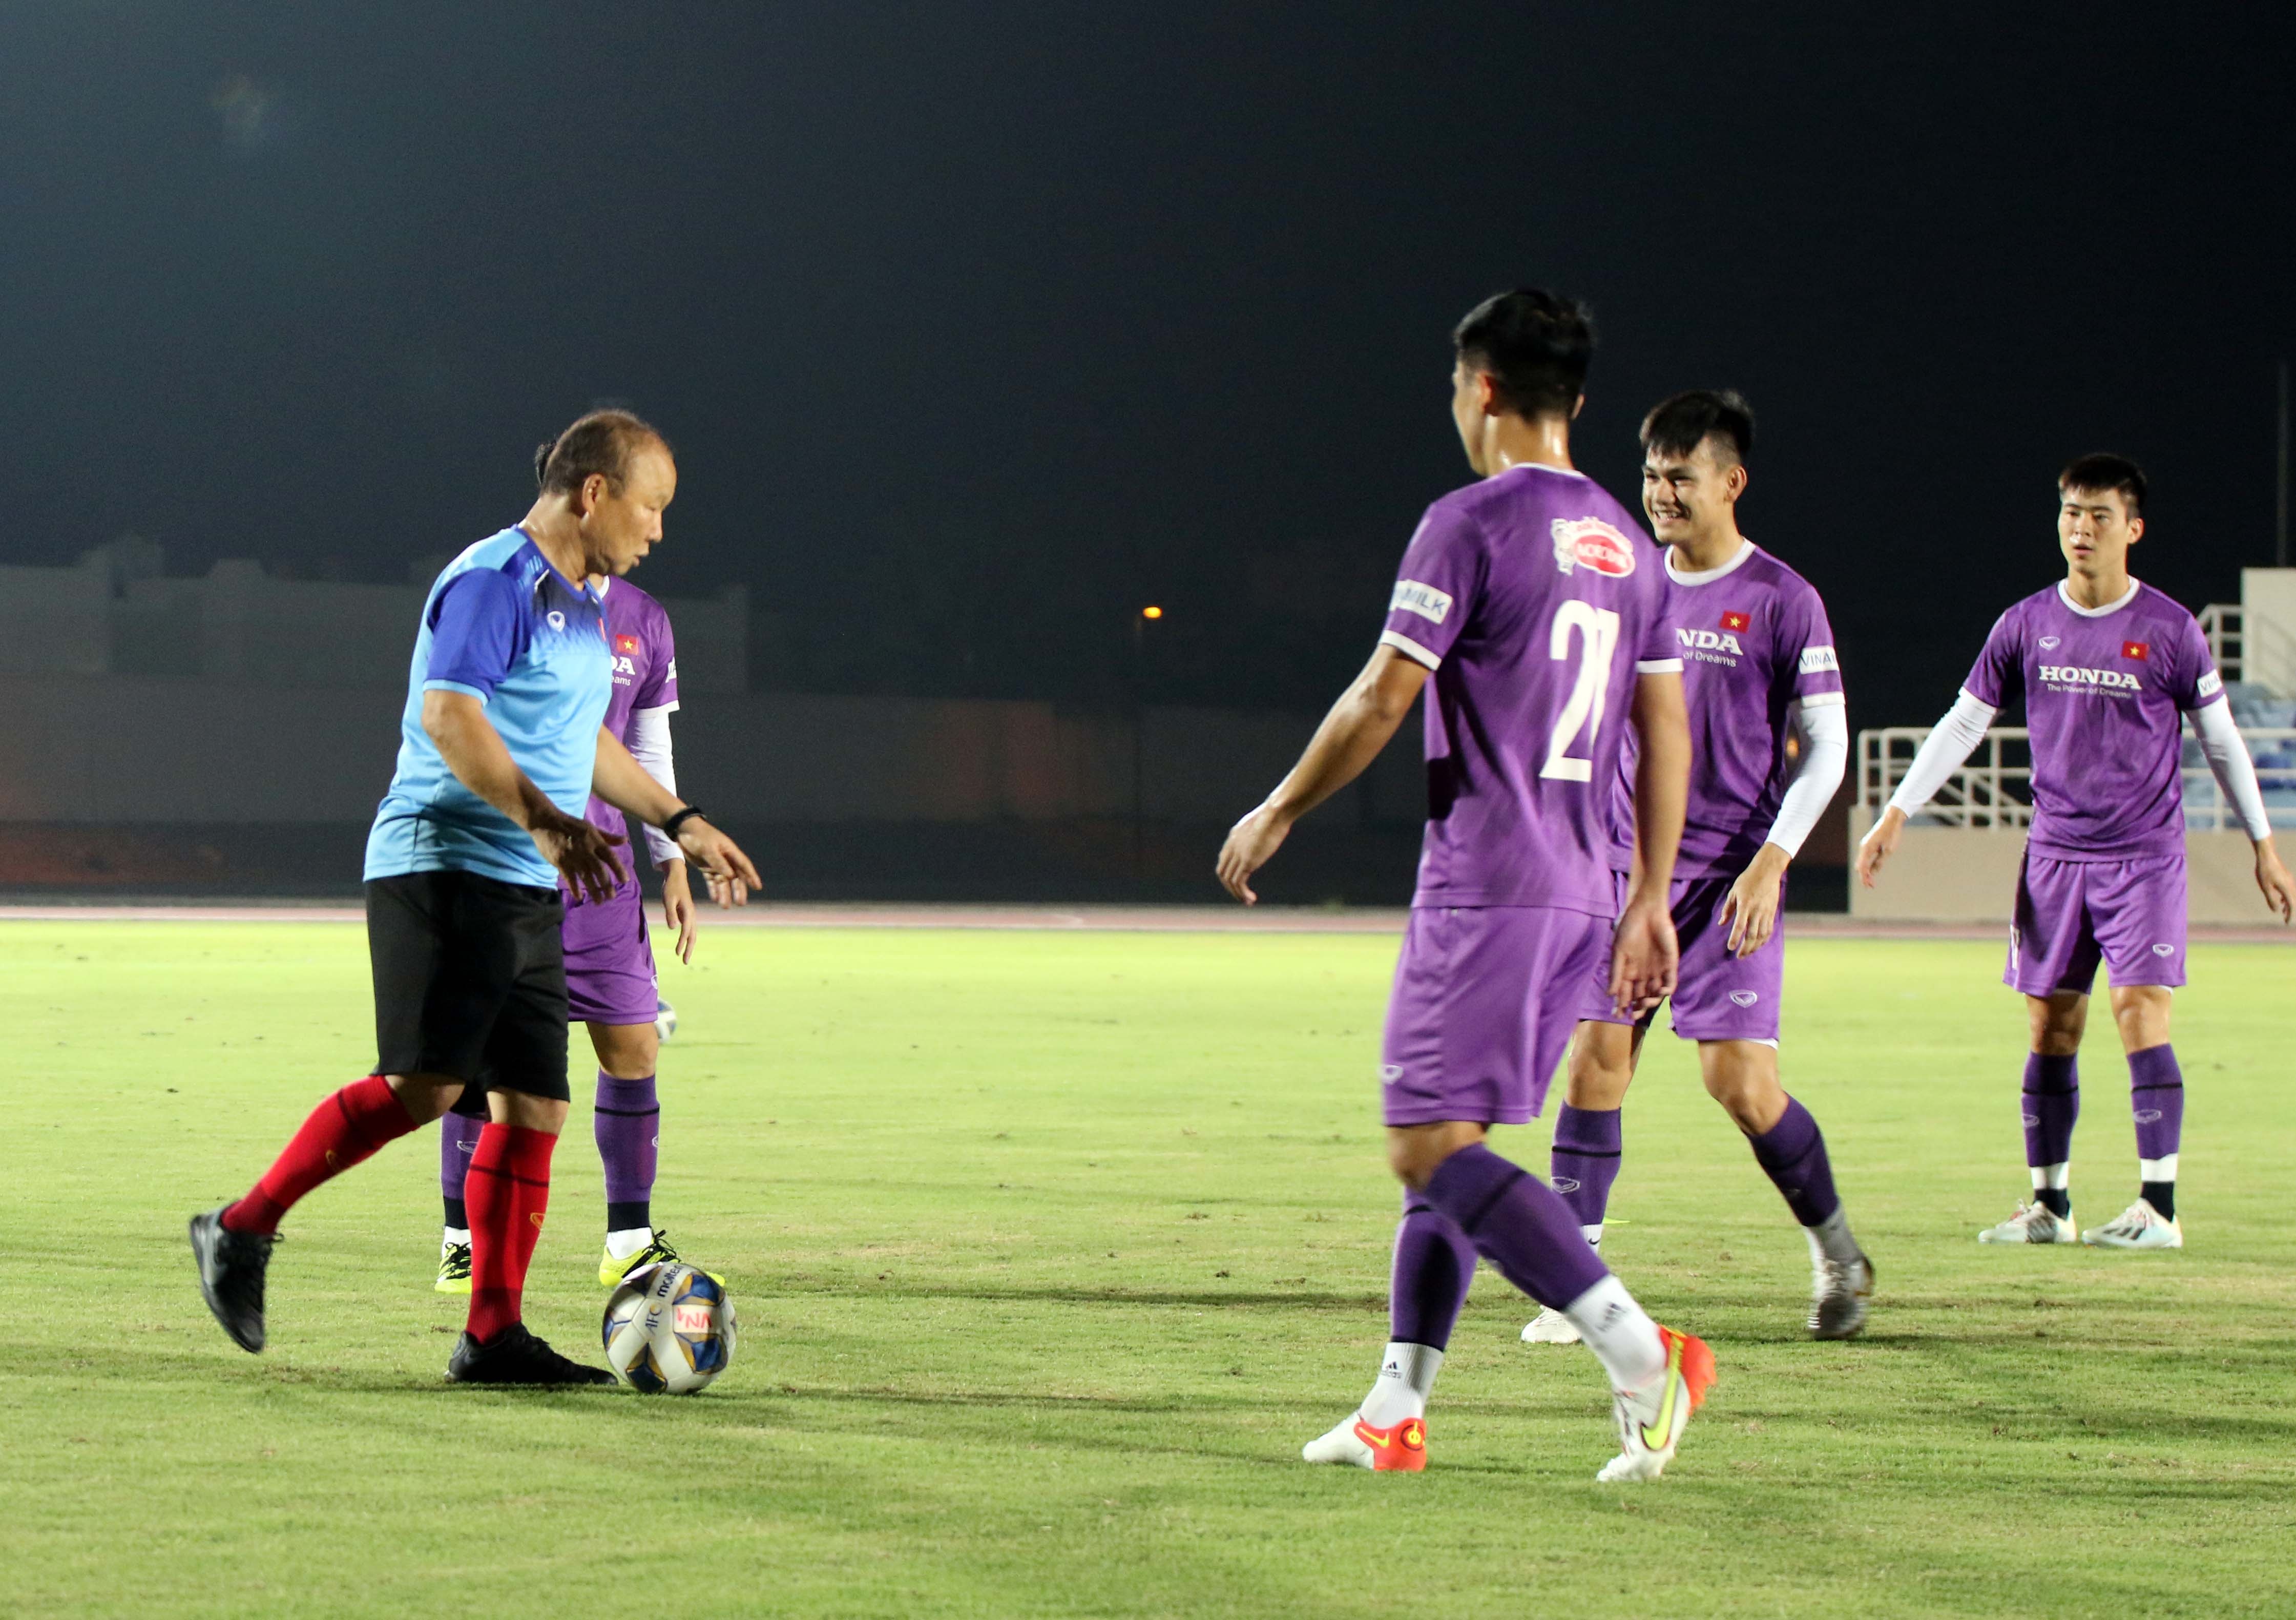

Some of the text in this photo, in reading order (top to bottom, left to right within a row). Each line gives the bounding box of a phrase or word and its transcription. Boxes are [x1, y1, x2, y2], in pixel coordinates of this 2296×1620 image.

[1695, 650, 1737, 667] Dreams
[1800, 651, 1835, 666] VINA
[2038, 666, 2142, 690] HONDA
[2047, 683, 2132, 699] The Power of Dreams
[657, 1264, 684, 1297] molten
[645, 1303, 662, 1334] AFC
